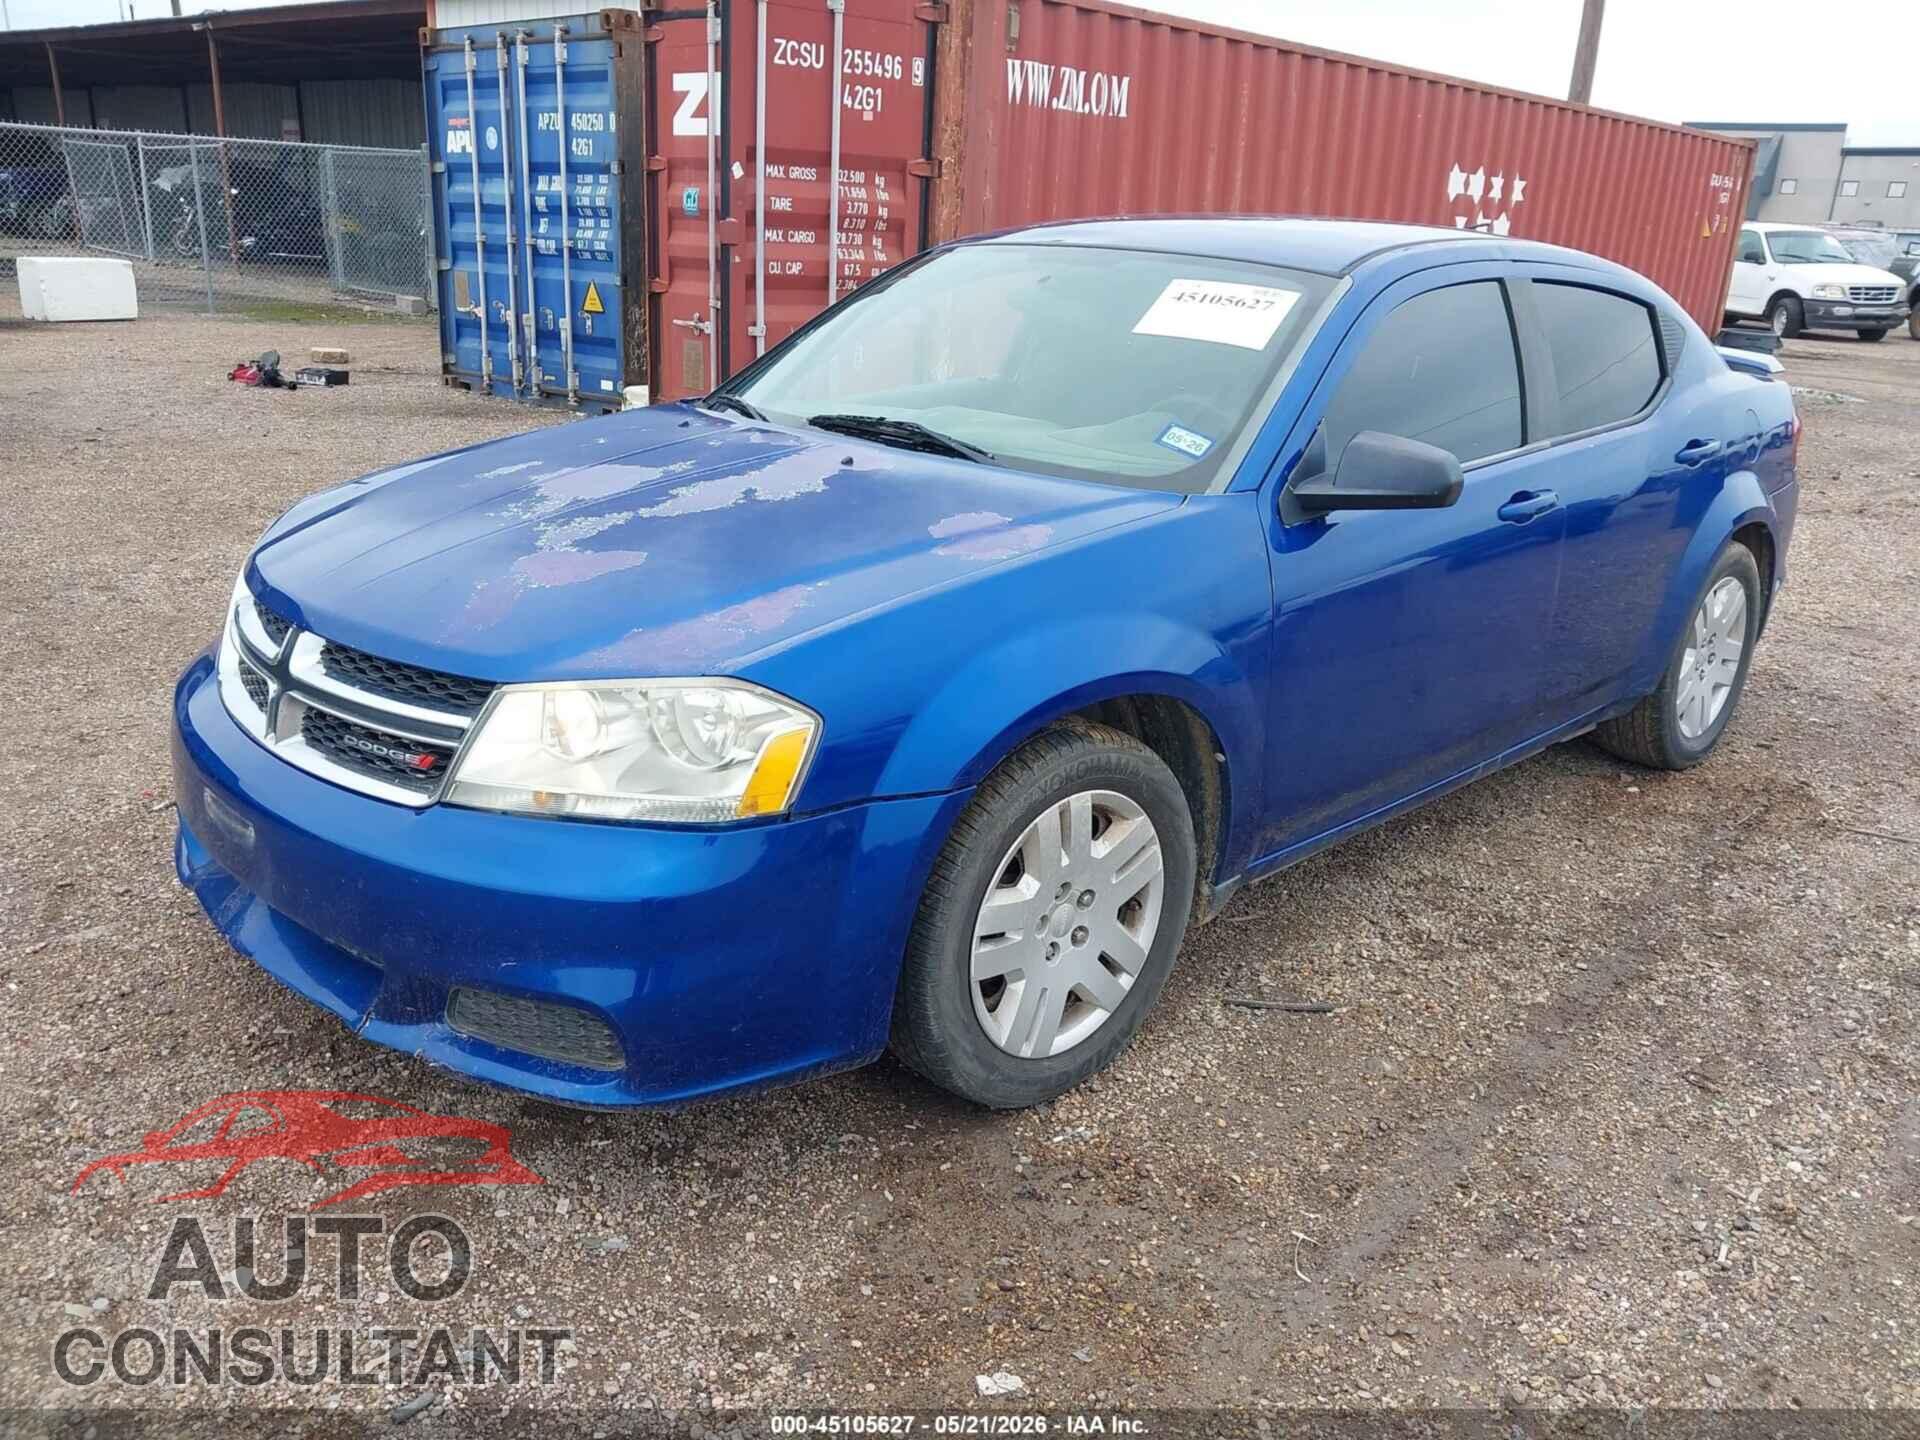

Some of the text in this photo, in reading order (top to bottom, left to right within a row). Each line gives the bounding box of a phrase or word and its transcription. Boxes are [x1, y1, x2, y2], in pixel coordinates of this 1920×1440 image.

[773, 38, 925, 86] ZCSU 255496 9
[843, 83, 882, 112] 42G1
[538, 112, 561, 131] APZU
[571, 112, 604, 131] 450250
[447, 130, 473, 153] APL
[571, 137, 593, 156] 42G1
[788, 166, 817, 181] GROSS
[875, 173, 885, 188] kg
[770, 196, 793, 211] TARE
[788, 230, 815, 244] CARGO
[344, 734, 420, 767] DODGE
